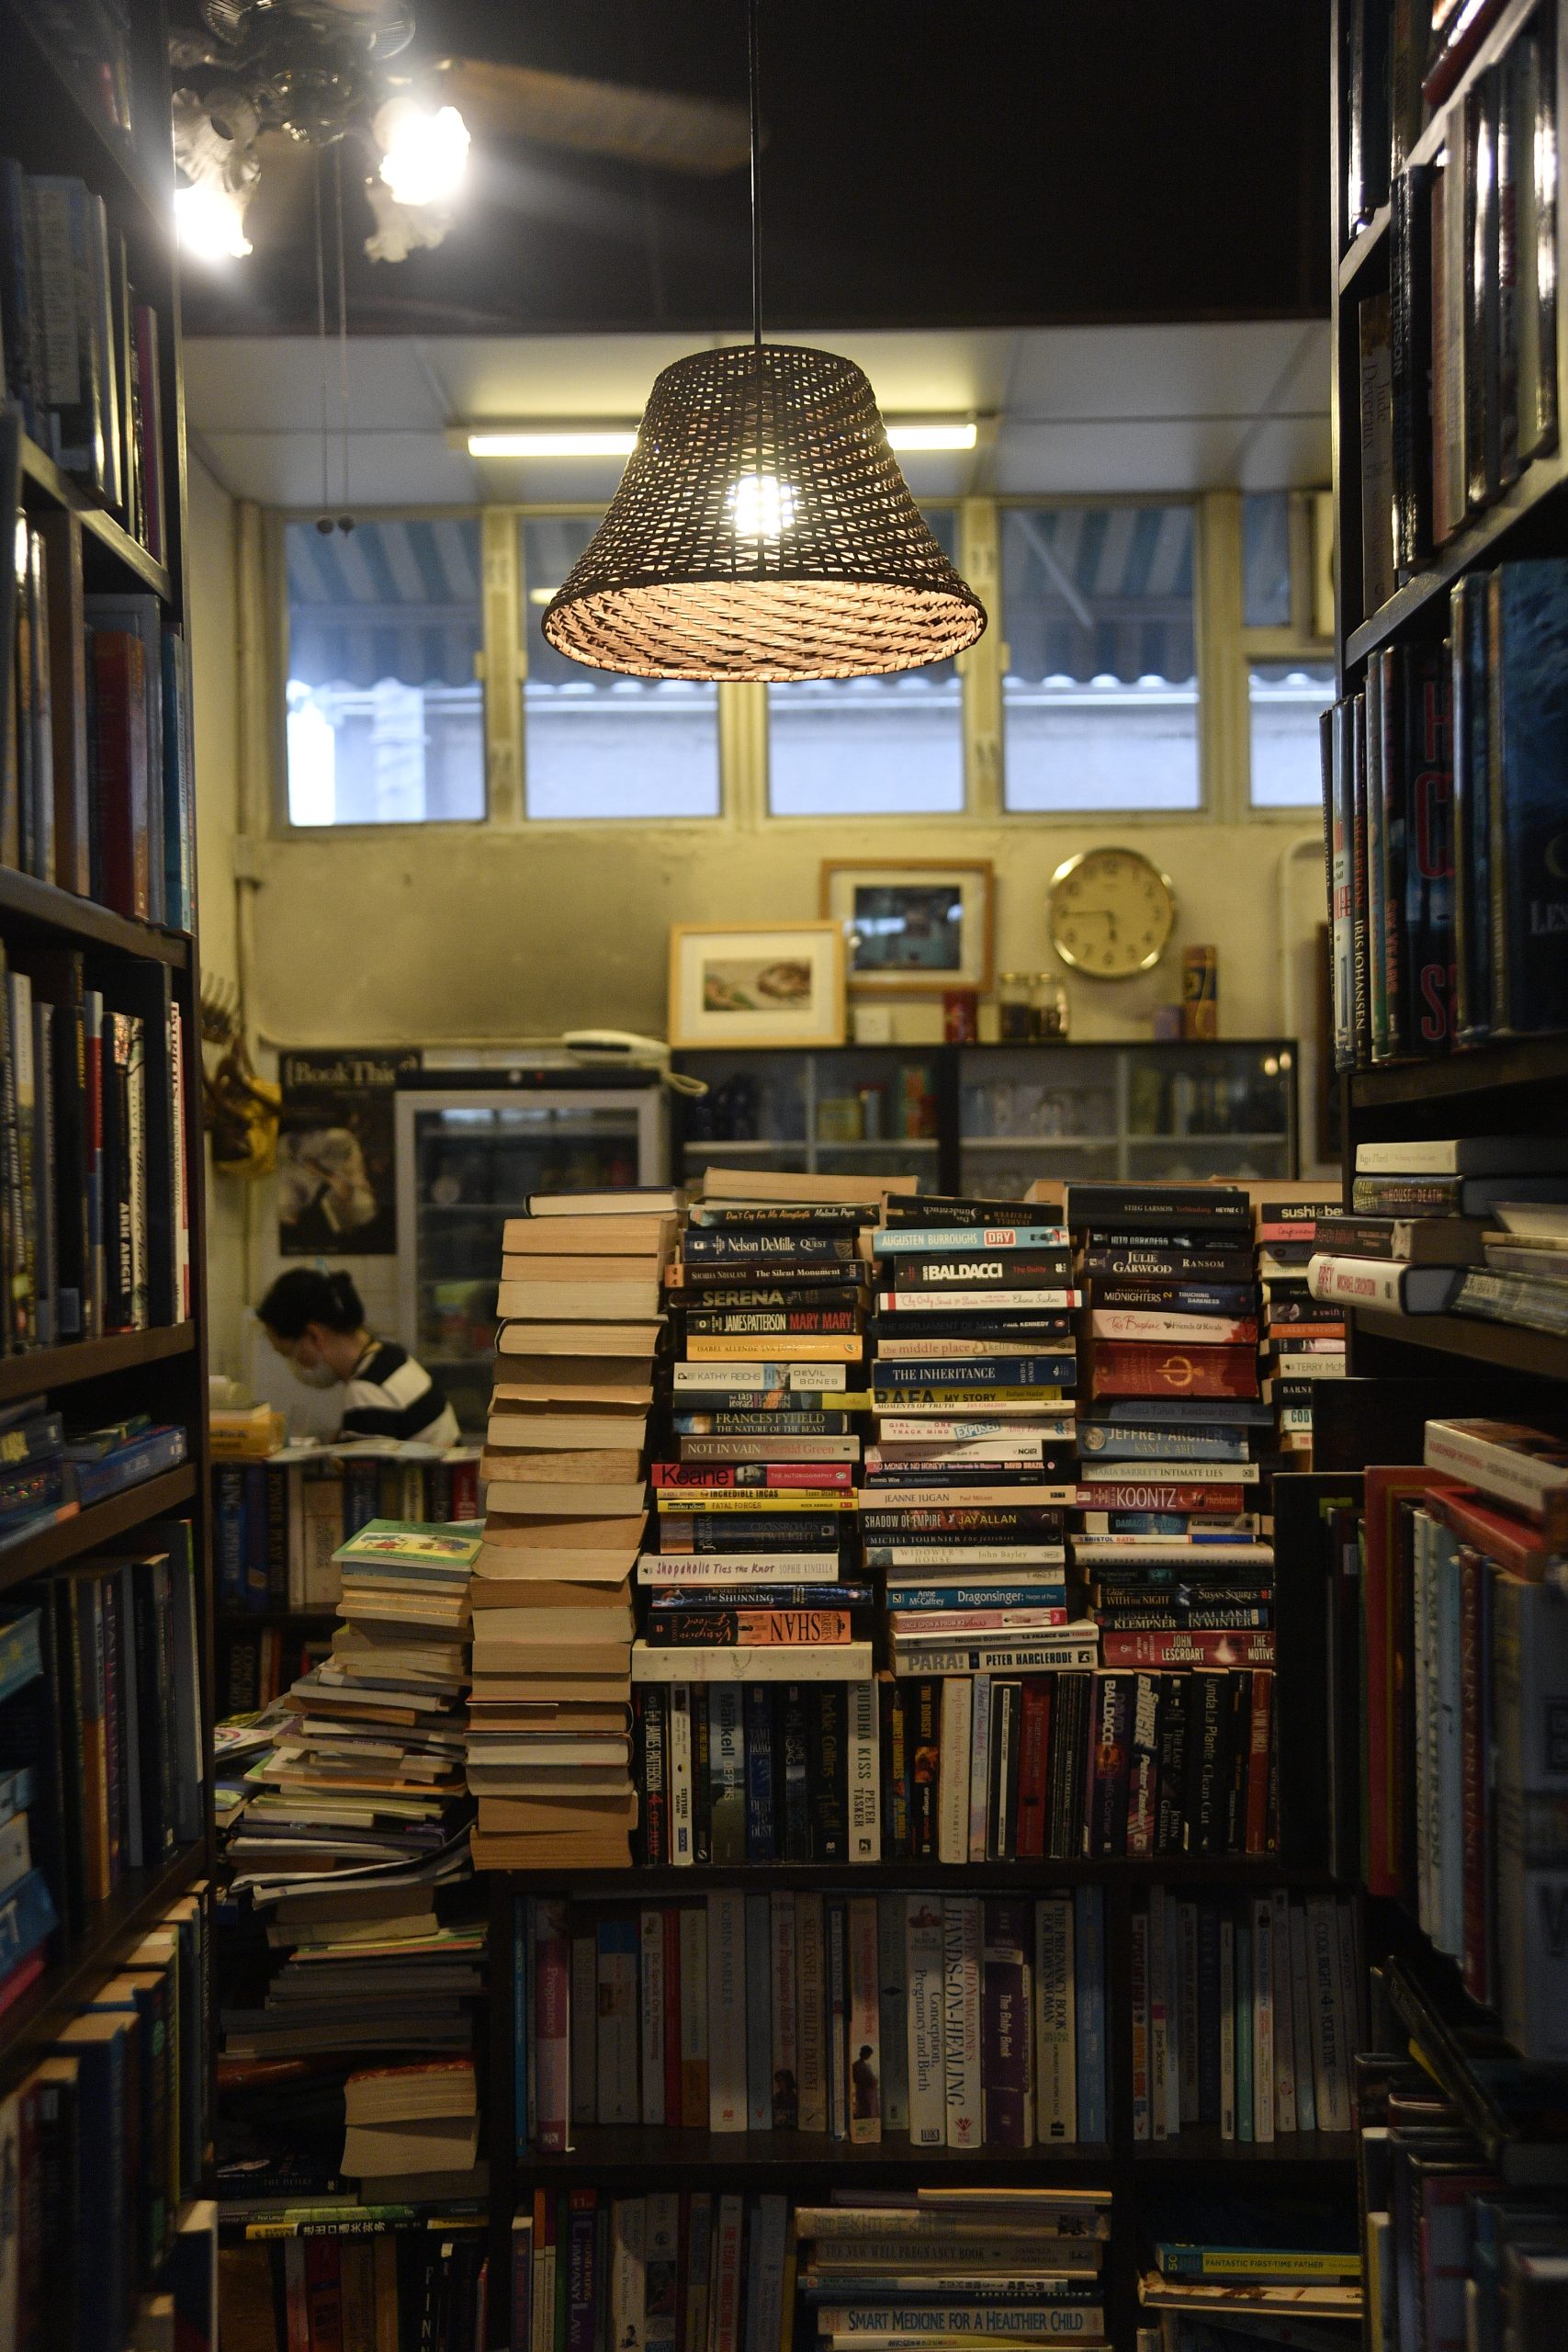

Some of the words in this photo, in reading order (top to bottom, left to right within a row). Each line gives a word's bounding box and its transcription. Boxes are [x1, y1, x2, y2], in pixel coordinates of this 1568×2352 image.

[1362, 364, 1378, 451] Deveraux
[1376, 383, 1391, 423] Jude
[1354, 919, 1364, 948] IRIS
[1354, 951, 1365, 1030] JOHANSEN
[1388, 1189, 1412, 1202] HOUSE
[1417, 1189, 1442, 1203] DEATH
[1280, 1205, 1315, 1218] sushi
[728, 1237, 759, 1250] Nelson
[761, 1237, 795, 1250] DeMille
[799, 1238, 828, 1251] QUEST
[881, 1235, 924, 1246] AUGUSTEN
[928, 1233, 977, 1245] BURROUGHS
[988, 1232, 1011, 1243] DRY
[1127, 1251, 1157, 1264] JULIE
[1182, 1258, 1224, 1268] RANSOM
[118, 1241, 130, 1295] ANGEL
[772, 1269, 795, 1277] Silent
[795, 1268, 840, 1276] Monument
[929, 1263, 1003, 1280] BALDACCI
[1112, 1261, 1172, 1273] GARWOOD
[702, 1289, 785, 1306] SERENA
[1103, 1291, 1161, 1303] MIDNIGHTERS
[790, 1312, 818, 1330] MARY
[821, 1312, 852, 1329] MARY
[1319, 1308, 1340, 1317] swift
[724, 1314, 748, 1331] JAMES
[747, 1314, 787, 1331] PATTERSON
[883, 1345, 897, 1354] the
[898, 1343, 939, 1354] middle
[942, 1343, 970, 1357] place
[892, 1369, 917, 1381] THE
[919, 1367, 996, 1380] INHERITANCE
[1295, 1363, 1323, 1371] TERRY
[697, 1372, 728, 1381] KATHY
[944, 1394, 960, 1402] MY
[963, 1393, 997, 1402] STORY
[716, 1413, 773, 1424] FRANCES
[775, 1413, 826, 1424] FYFIELD
[956, 1420, 1000, 1439] EXPOSED
[1108, 1428, 1162, 1441] JEFFREY
[1168, 1428, 1224, 1442] ARCHER
[687, 1443, 716, 1454] NOT
[716, 1443, 729, 1454] IN
[732, 1443, 761, 1454] VAIN
[661, 1464, 728, 1486] Keane
[1160, 1468, 1203, 1476] INTIMATE
[1204, 1468, 1223, 1476] LIES
[885, 1495, 917, 1504] JEANNE
[918, 1493, 950, 1502] JUGAN
[1116, 1487, 1177, 1508] KOONTZ
[864, 1515, 899, 1529] SHADOW
[900, 1515, 911, 1528] OF
[912, 1514, 941, 1527] EMPIRE
[958, 1516, 979, 1525] JAY
[980, 1515, 1017, 1524] ALLAN
[910, 1535, 962, 1544] TOURNIER
[900, 1548, 964, 1556] WIDOWER'S
[977, 1550, 998, 1558] John
[1000, 1550, 1027, 1558] Bayley
[656, 1561, 710, 1577] Shopaholic
[713, 1564, 732, 1574] Ties
[735, 1565, 749, 1573] the
[750, 1564, 775, 1574] Knot
[718, 1594, 774, 1604] SHUNNING
[908, 1597, 945, 1607] McCaffrey
[917, 1589, 936, 1598] Anne
[957, 1590, 1023, 1605] Dragonsinger:
[1142, 1596, 1169, 1605] NIGHT
[770, 1613, 820, 1642] SHAN
[1113, 1618, 1176, 1629] KLEMPNER
[1204, 1617, 1251, 1627] WINTER
[1172, 1635, 1191, 1647] JOHN
[1252, 1635, 1266, 1646] THE
[987, 1654, 1012, 1667] PETER
[1016, 1651, 1073, 1665] HARCLERODE
[1161, 1648, 1204, 1661] LESCROART
[1247, 1647, 1274, 1660] MOTIVE
[920, 1685, 931, 1702] TIM
[1203, 1678, 1220, 1709] Lynda
[821, 1691, 838, 1732] Jackie
[856, 1684, 871, 1741] BUDDHA
[1101, 1679, 1116, 1746] BALDACCI
[1205, 1710, 1217, 1723] La
[719, 1693, 735, 1756] Mankell
[920, 1703, 931, 1739] DORSEY
[646, 1724, 661, 1748] JAMES
[1204, 1725, 1218, 1759] Plante
[821, 1735, 838, 1777] Collins
[858, 1747, 871, 1780] KISS
[646, 1750, 662, 1792] PATTERSON
[1139, 1753, 1151, 1787] Peter
[723, 1759, 734, 1801] DEPTHS
[1201, 1764, 1214, 1799] Clean
[648, 1792, 663, 1805] 4
[854, 1787, 864, 1827] TASKER
[865, 1790, 875, 1824] PETER
[921, 1787, 931, 1815] orange
[1137, 1789, 1150, 1827] Tasker
[1201, 1801, 1213, 1825] Cut
[649, 1810, 659, 1824] OF
[1158, 1800, 1170, 1848] GRISHAM
[1043, 1911, 1055, 1933] FOR
[1055, 1905, 1067, 1928] THE
[963, 1908, 977, 1997] PREVENTION
[1055, 1931, 1067, 1996] PREGNANCY
[721, 1950, 733, 2004] BARKER
[541, 1965, 558, 2035] Pregnancy
[912, 1968, 928, 2030] Pregnancy
[944, 1907, 964, 2106] HANDS-ON-HEALING
[999, 1993, 1012, 2010] The
[1043, 1982, 1055, 2023] WOMAN
[998, 2011, 1012, 2033] Baby
[1055, 1997, 1067, 2030] BOOK
[928, 1991, 942, 2067] Conception,
[918, 2033, 929, 2057] and
[999, 2035, 1013, 2057] Book
[918, 2059, 930, 2091] Birth
[1205, 2259, 1247, 2267] FANTASTIC
[1293, 2260, 1324, 2268] FATHER
[849, 2310, 888, 2331] SMART
[892, 2310, 945, 2331] MEDICINE
[949, 2310, 971, 2330] FOR
[974, 2311, 983, 2330] A
[987, 2310, 1047, 2331] HEALTHIER
[1050, 2310, 1084, 2331] CHILD
